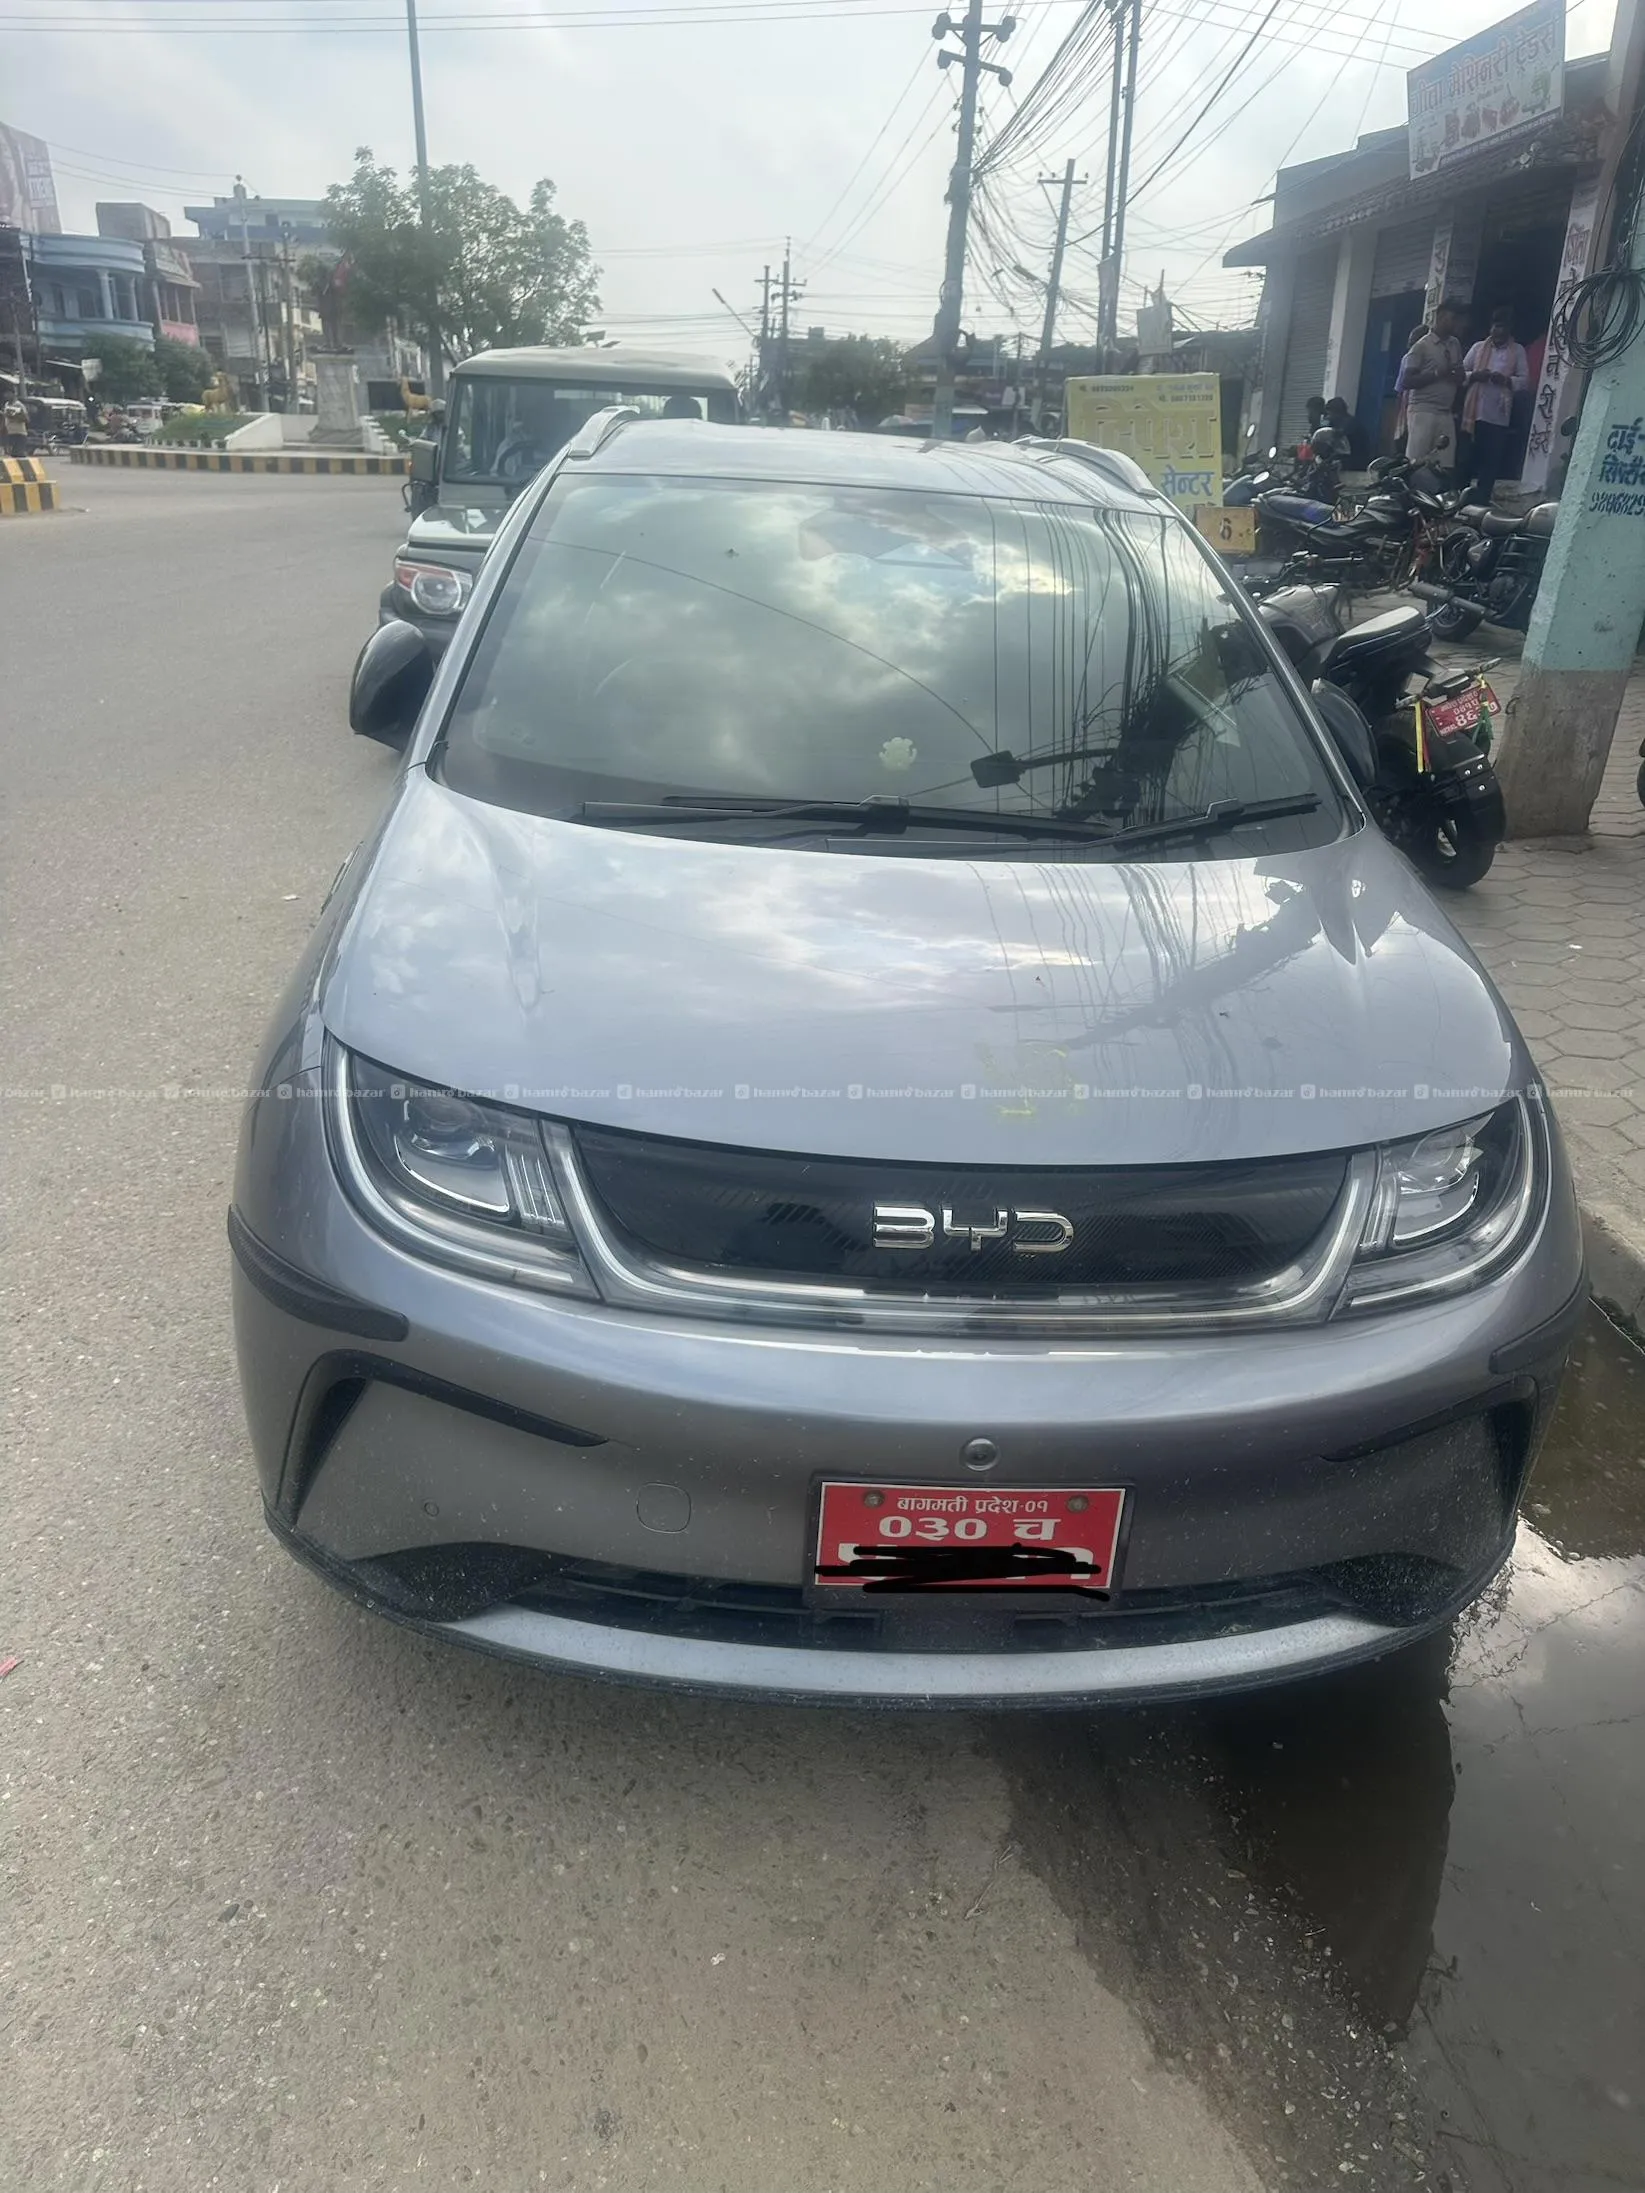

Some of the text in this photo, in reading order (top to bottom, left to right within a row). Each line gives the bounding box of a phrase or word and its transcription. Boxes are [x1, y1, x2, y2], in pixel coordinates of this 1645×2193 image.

[873, 1201, 1074, 1252] BYD
[896, 1496, 967, 1513] बागमती
[878, 1515, 1062, 1541] ०३० च
